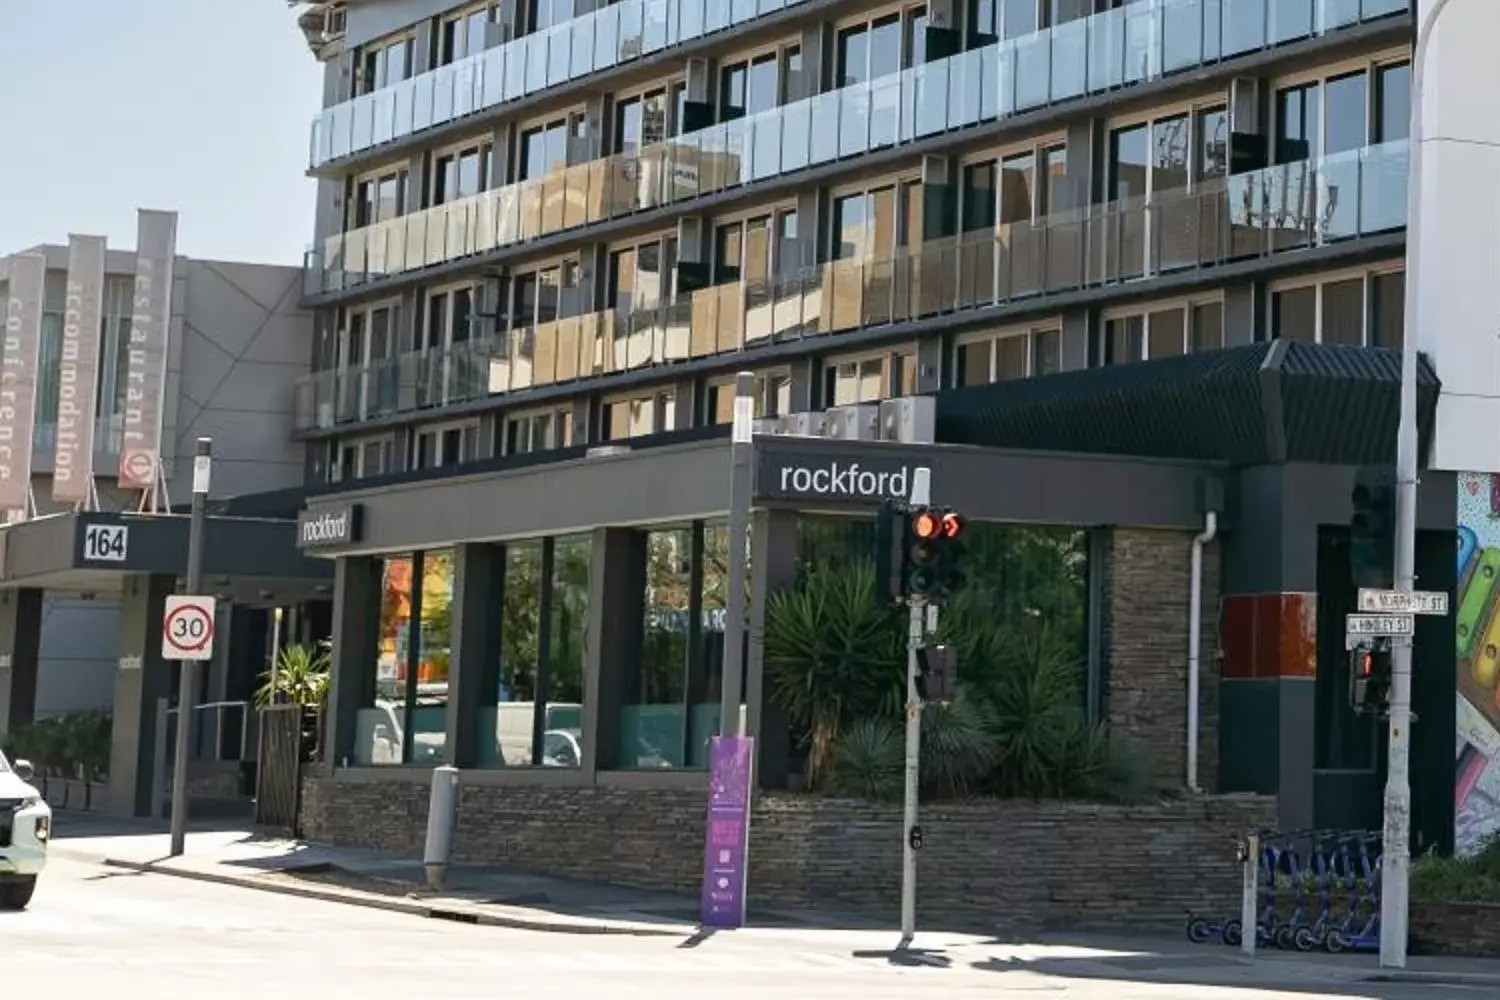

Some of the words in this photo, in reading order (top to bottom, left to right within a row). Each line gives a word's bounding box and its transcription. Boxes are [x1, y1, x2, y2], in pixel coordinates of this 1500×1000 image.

[124, 257, 153, 441] restaurant
[54, 281, 83, 483] accommodation
[781, 462, 907, 497] rockford
[303, 511, 347, 541] rockford
[87, 528, 125, 557] 164
[173, 617, 204, 638] 30
